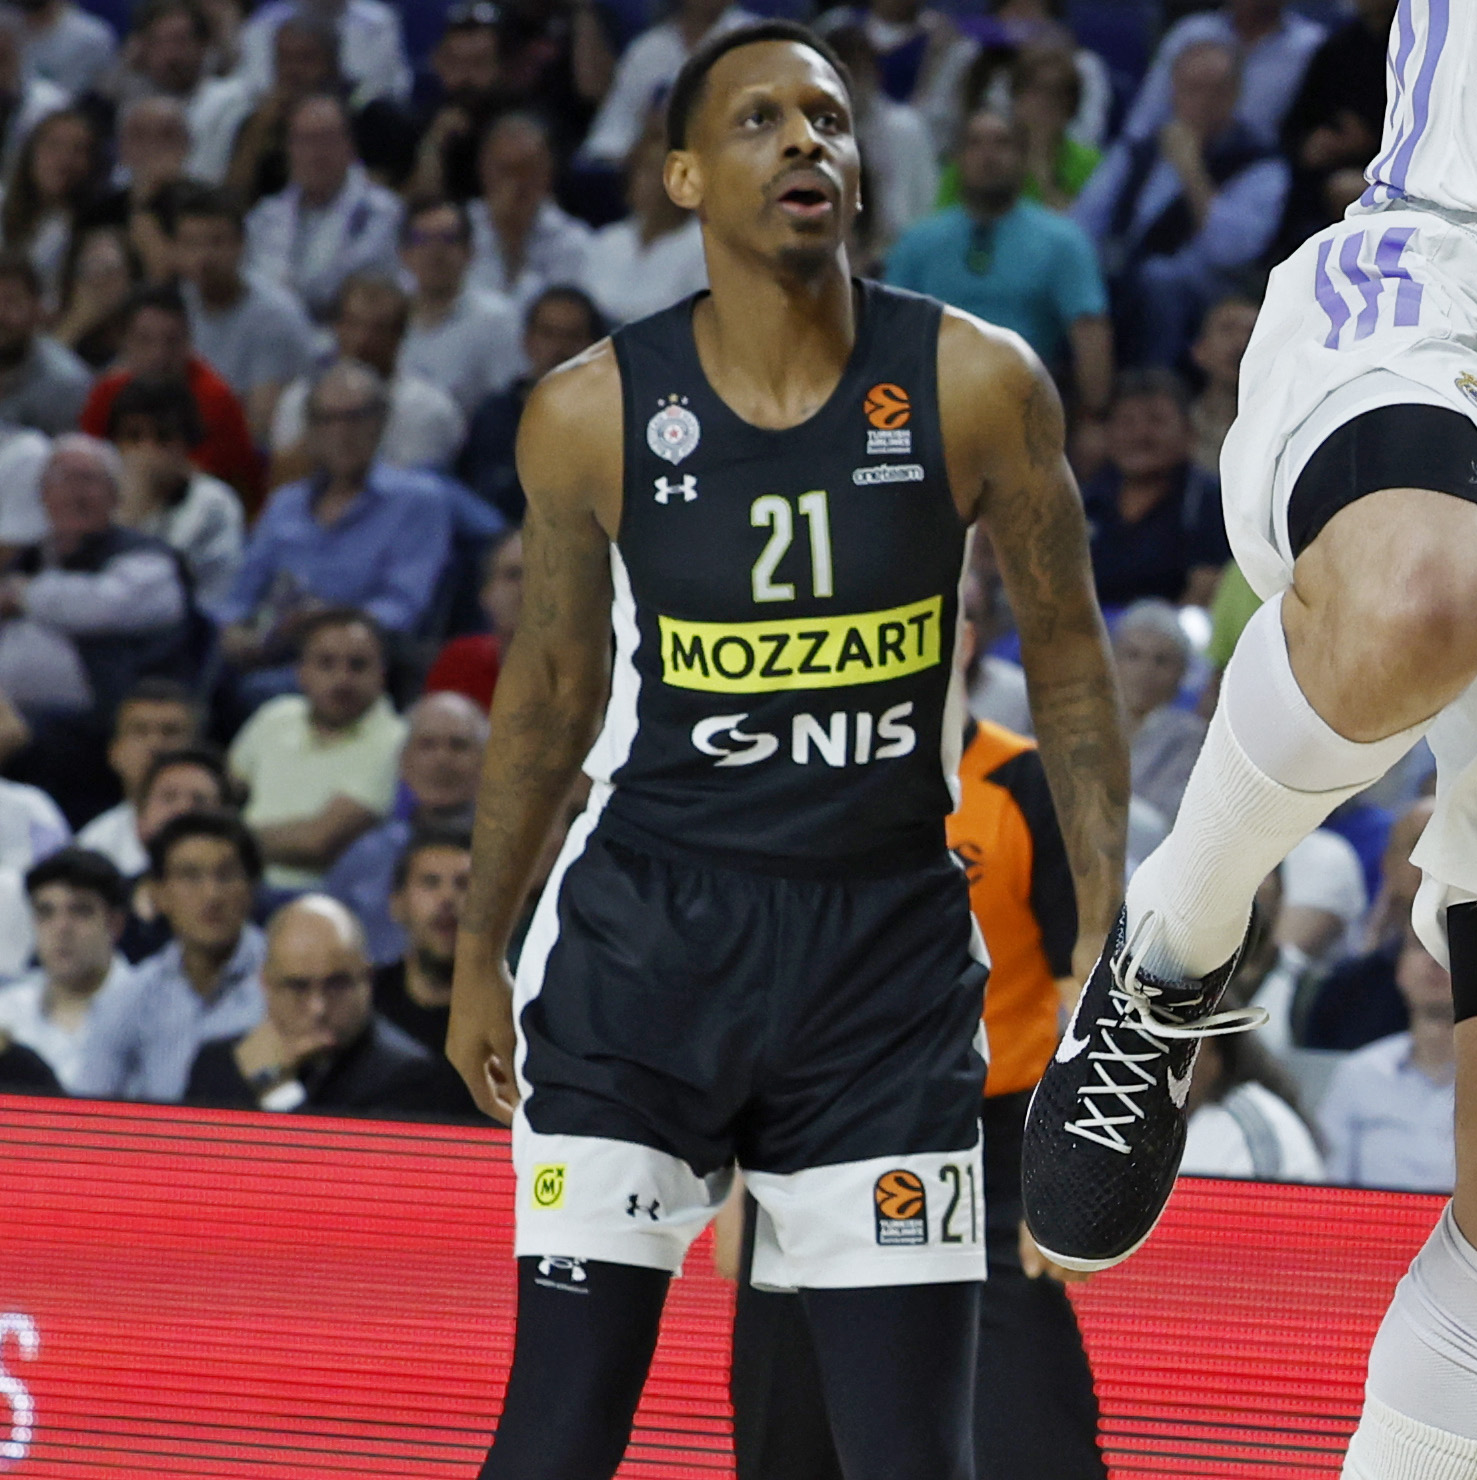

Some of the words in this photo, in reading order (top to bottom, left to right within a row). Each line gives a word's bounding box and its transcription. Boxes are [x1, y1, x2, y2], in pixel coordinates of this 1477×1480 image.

[750, 490, 834, 603] 21
[670, 611, 935, 680] MOZZART
[791, 701, 917, 767] NIS
[939, 1164, 977, 1243] 21
